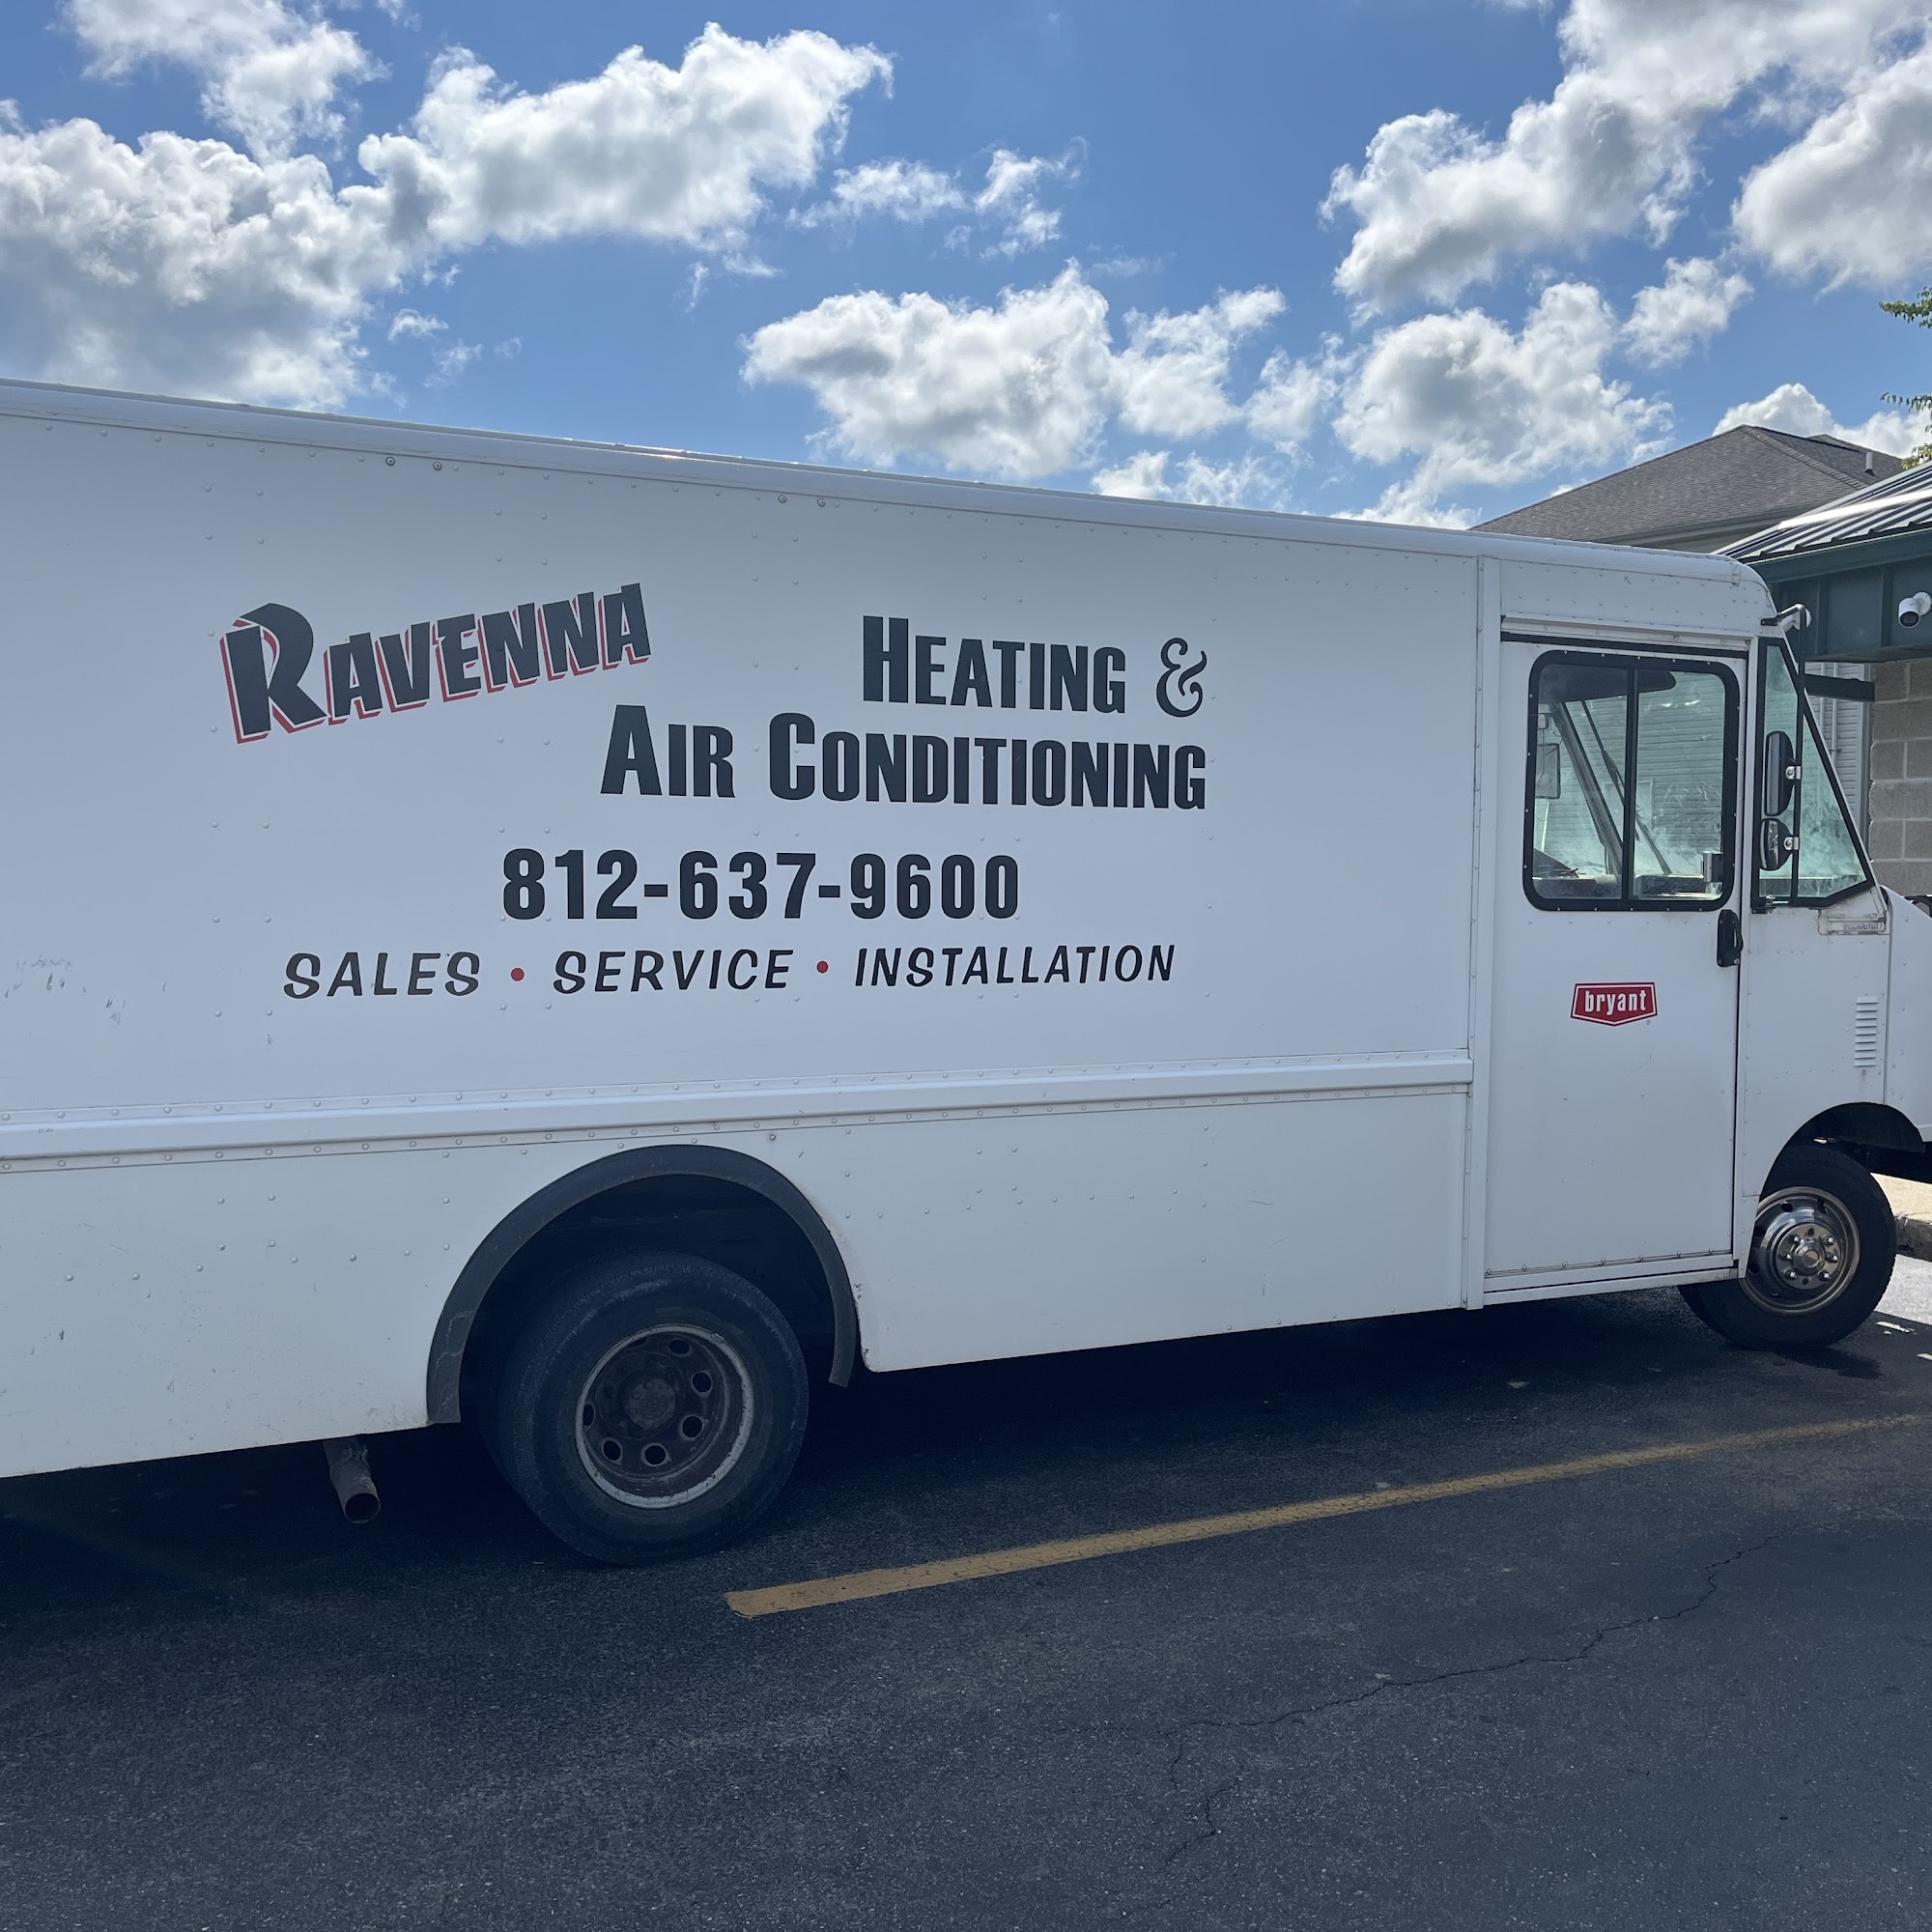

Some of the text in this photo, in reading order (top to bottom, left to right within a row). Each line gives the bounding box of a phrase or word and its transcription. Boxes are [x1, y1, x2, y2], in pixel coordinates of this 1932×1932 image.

[220, 582, 653, 744] RAVENNA
[863, 615, 1208, 718] HEATING &
[600, 704, 1206, 810] AIR CONDITIONING
[502, 848, 1019, 921] 812-637-9600
[283, 944, 1176, 999] SALES SERVICE INSTALLATION
[1584, 989, 1647, 1016] bryant
